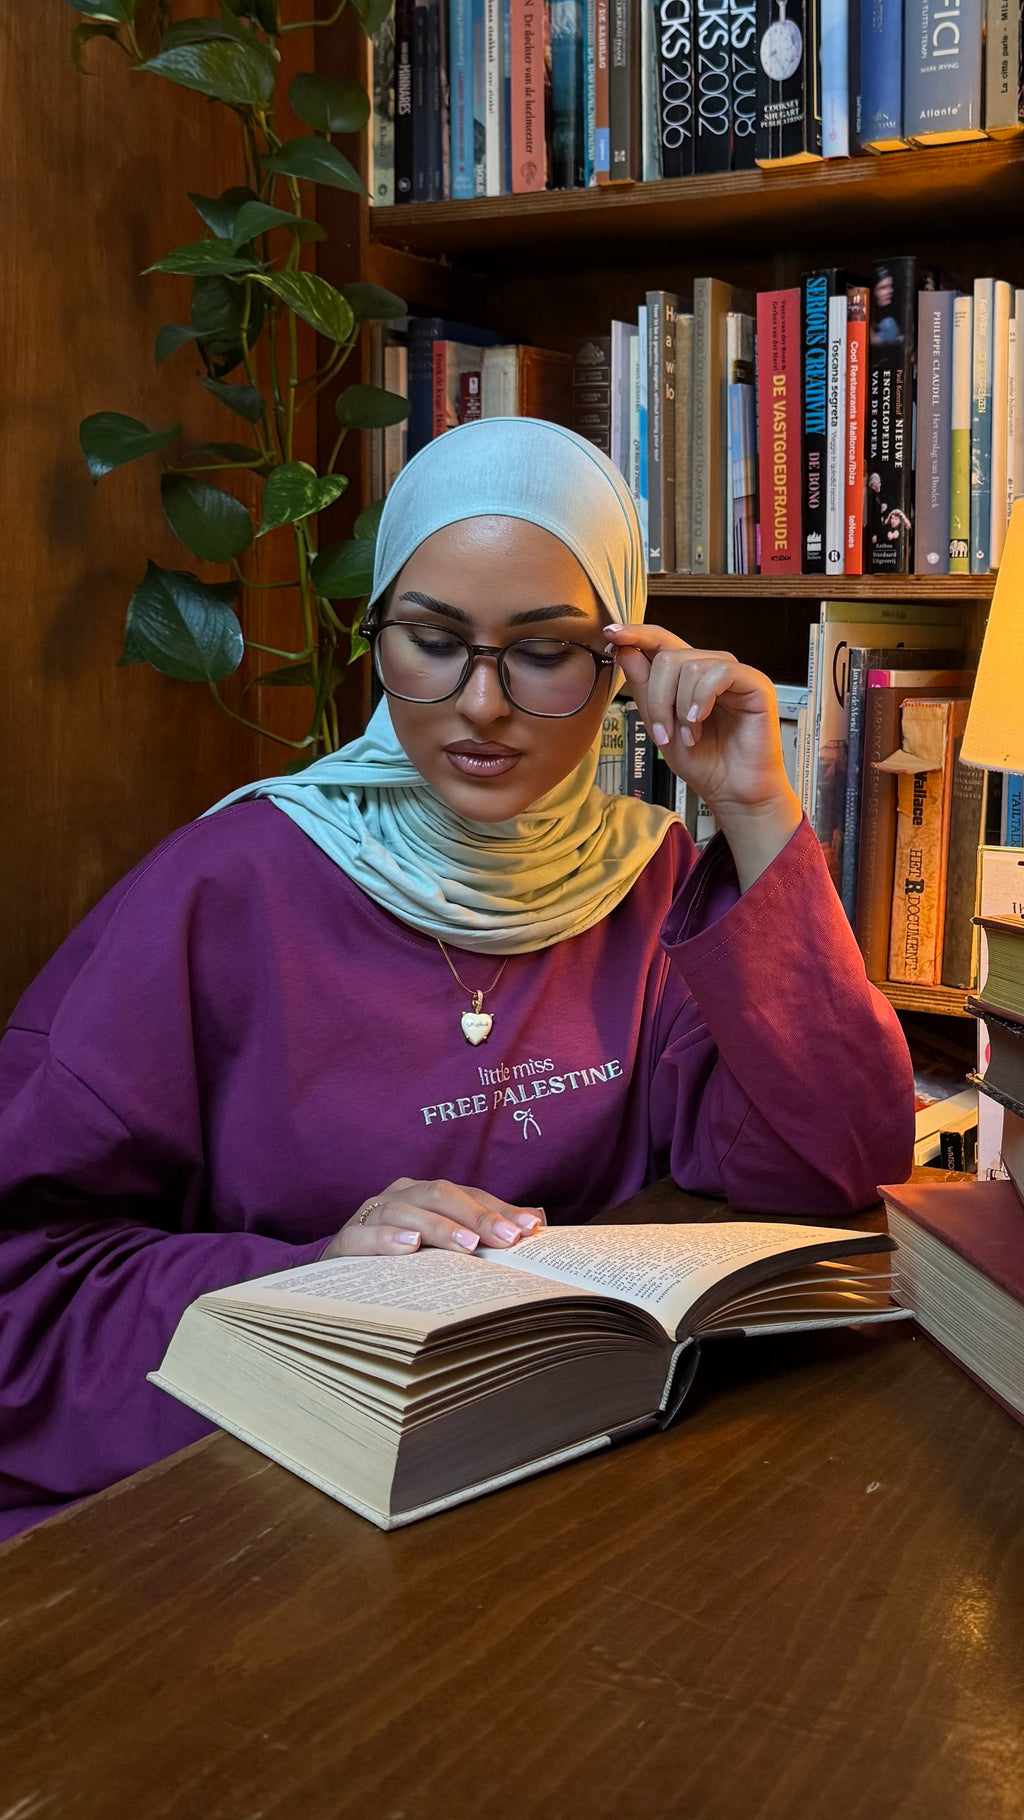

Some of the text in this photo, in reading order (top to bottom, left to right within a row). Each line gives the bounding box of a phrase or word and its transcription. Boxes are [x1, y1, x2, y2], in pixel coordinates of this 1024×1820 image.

[599, 9, 606, 22] DE
[1001, 35, 1009, 57] parla
[730, 0, 756, 137] KS 2008
[920, 62, 959, 74] MARK IRVING
[398, 64, 411, 115] MINNARES
[523, 14, 536, 153] De dochter van de heelmeester
[698, 52, 729, 136] 2002
[1001, 83, 1008, 94] La
[661, 61, 692, 148] 2006
[763, 99, 800, 112] COOKSEY
[764, 107, 800, 121] SHUGART
[760, 114, 805, 128] PUBLICATIONS
[653, 320, 659, 328] to
[771, 301, 779, 326] Gerben
[651, 341, 660, 363] graphic
[779, 345, 787, 364] Boon
[831, 338, 841, 383] Toscana
[772, 374, 786, 397] DE
[805, 276, 827, 509] SERIOUS CREATIVITY DE BONO
[694, 380, 706, 442] Encyclopedia
[829, 385, 840, 427] segreta
[870, 370, 879, 458] VAN DE OPERA
[881, 370, 890, 462] ENCYCLOPEDIE
[894, 369, 903, 469] Paul Korenhof NIEUWE
[930, 311, 941, 509] PHILIPPE CLAUDEL Het verslag van Brodeck
[652, 416, 660, 434] losing
[829, 431, 837, 455] Viaggio
[848, 340, 859, 548] Cool Restaurants Mallorca/Ibiza teNeues
[695, 460, 706, 489] Flower
[772, 400, 788, 550] VASTGOEDFRAUDE
[693, 491, 706, 537] Arranging
[871, 557, 897, 565] Uitgeverij
[851, 668, 861, 681] Jan
[850, 694, 859, 706] de
[635, 721, 645, 731] L.
[635, 733, 646, 743] B.
[634, 747, 646, 778] Rubin
[870, 751, 881, 793] GSEN
[904, 848, 924, 970] HET R DOCUMENT
[478, 1057, 555, 1087] little miss
[420, 1059, 624, 1126] FREE PALESTINE
[947, 1146, 955, 1171] WATSO
